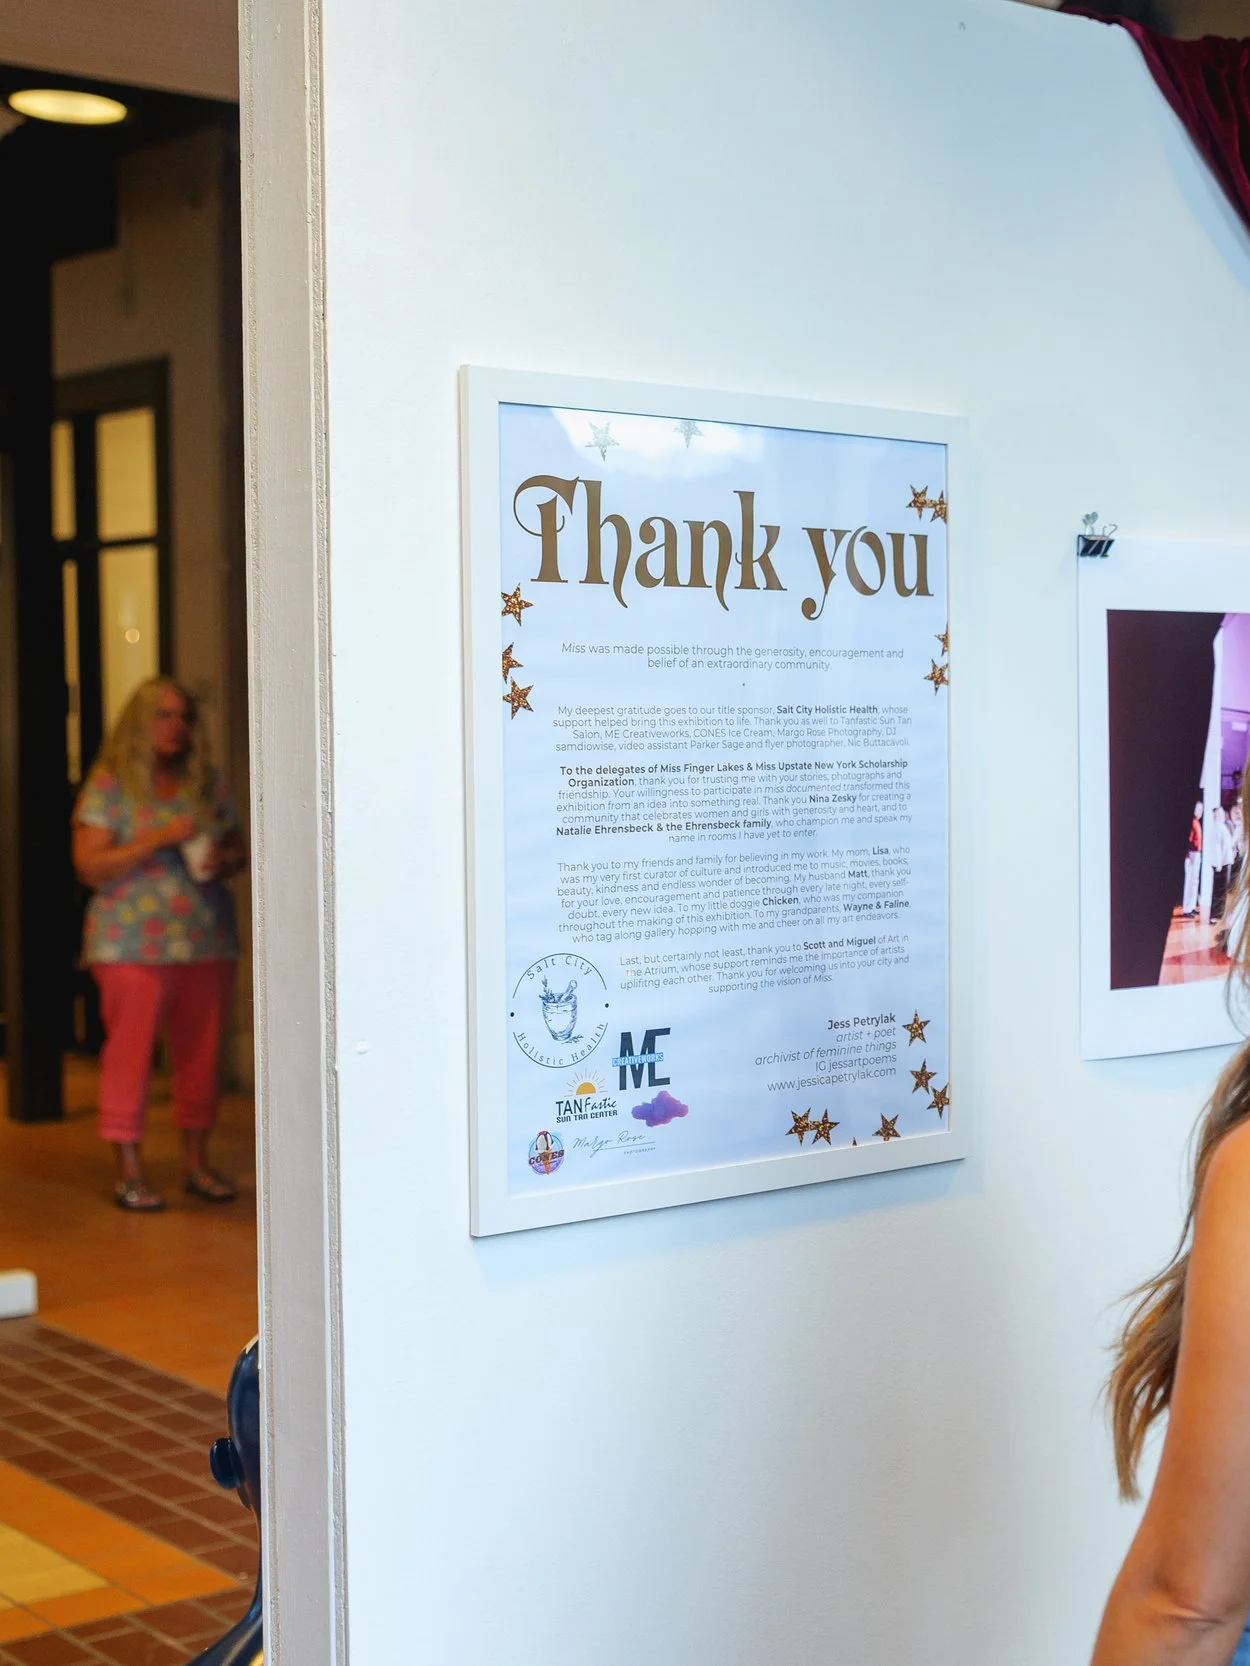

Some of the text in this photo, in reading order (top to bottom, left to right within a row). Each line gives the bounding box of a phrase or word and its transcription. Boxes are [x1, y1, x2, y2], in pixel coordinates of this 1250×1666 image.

[513, 475, 934, 621] Thank you
[561, 642, 904, 660] Miss was made possible through the generosity, encouragement and
[647, 656, 677, 667] belief
[678, 657, 689, 667] of
[706, 657, 772, 671] extraordinary
[774, 658, 832, 671] community.
[558, 705, 573, 716] My
[574, 705, 614, 716] deepest
[616, 705, 661, 716] gratitude
[663, 708, 686, 716] goes
[688, 706, 698, 714] to
[717, 705, 735, 713] title
[776, 705, 793, 713] Salt
[795, 705, 813, 715] City
[814, 705, 847, 713] Holistic
[572, 729, 603, 739] Salon,
[604, 729, 620, 738] ME
[693, 728, 726, 737] CONES
[728, 728, 741, 736] Ice
[777, 727, 805, 738] Margo
[806, 727, 826, 735] Rose
[559, 759, 908, 776] To the delegates of Miss Finger Lakes & Miss Upstate New York Scholarship
[638, 776, 666, 785] thank
[667, 778, 685, 786] you
[687, 775, 700, 783] for
[702, 774, 738, 785] trusting
[757, 773, 777, 781] with
[778, 775, 798, 783] your
[831, 770, 885, 782] photographs
[886, 770, 902, 778] and
[556, 825, 592, 835] Natalie
[594, 823, 653, 833] Ehrensbeck
[656, 822, 663, 831] &
[665, 822, 682, 830] the
[685, 819, 740, 830] Ehrensbeck
[775, 817, 794, 826] who
[796, 816, 839, 827] champion
[856, 814, 872, 823] and
[874, 813, 898, 824] speak
[899, 815, 912, 823] my
[697, 832, 706, 841] in
[743, 830, 765, 839] have
[766, 830, 780, 840] yet
[782, 829, 791, 837] to
[595, 882, 639, 893] kindness
[641, 881, 659, 890] and
[661, 879, 696, 889] endless
[697, 877, 732, 887] wonder
[734, 876, 743, 885] of
[744, 873, 792, 886] becoming.
[793, 872, 807, 883] My
[808, 870, 845, 880] husband
[871, 867, 895, 876] thank
[896, 868, 911, 877] you
[558, 919, 615, 934] throughout
[617, 918, 634, 927] the
[636, 915, 673, 928] making
[675, 914, 685, 923] of
[686, 913, 704, 922] this
[705, 910, 752, 921] exhibition.
[753, 909, 764, 917] To
[766, 910, 779, 919] my
[843, 901, 873, 913] Wayne
[875, 900, 881, 908] &
[527, 955, 592, 979] Salt City
[625, 967, 642, 977] the
[680, 961, 711, 972] whose
[712, 958, 749, 971] support
[751, 954, 787, 965] reminds
[804, 951, 819, 961] the
[820, 947, 868, 961] importance
[869, 946, 879, 955] of
[880, 944, 905, 954] artists
[708, 980, 758, 995] supporting
[760, 978, 775, 987] the
[776, 975, 801, 986] vision
[802, 974, 812, 983] of
[828, 1013, 895, 1029] Jess Petrylak
[836, 1030, 863, 1042] artist
[873, 1027, 896, 1039] poet
[517, 1023, 604, 1065] Holistic Health
[755, 1040, 896, 1065] archivist of feminine things
[613, 1053, 663, 1067] CREATIVEWORKS
[815, 1054, 896, 1072] IG jessartpoems
[767, 1067, 896, 1092] www.jessicapetrylak.com
[556, 1116, 571, 1124] SUN
[591, 1110, 618, 1120] CENTER
[617, 1130, 646, 1143] Rose
